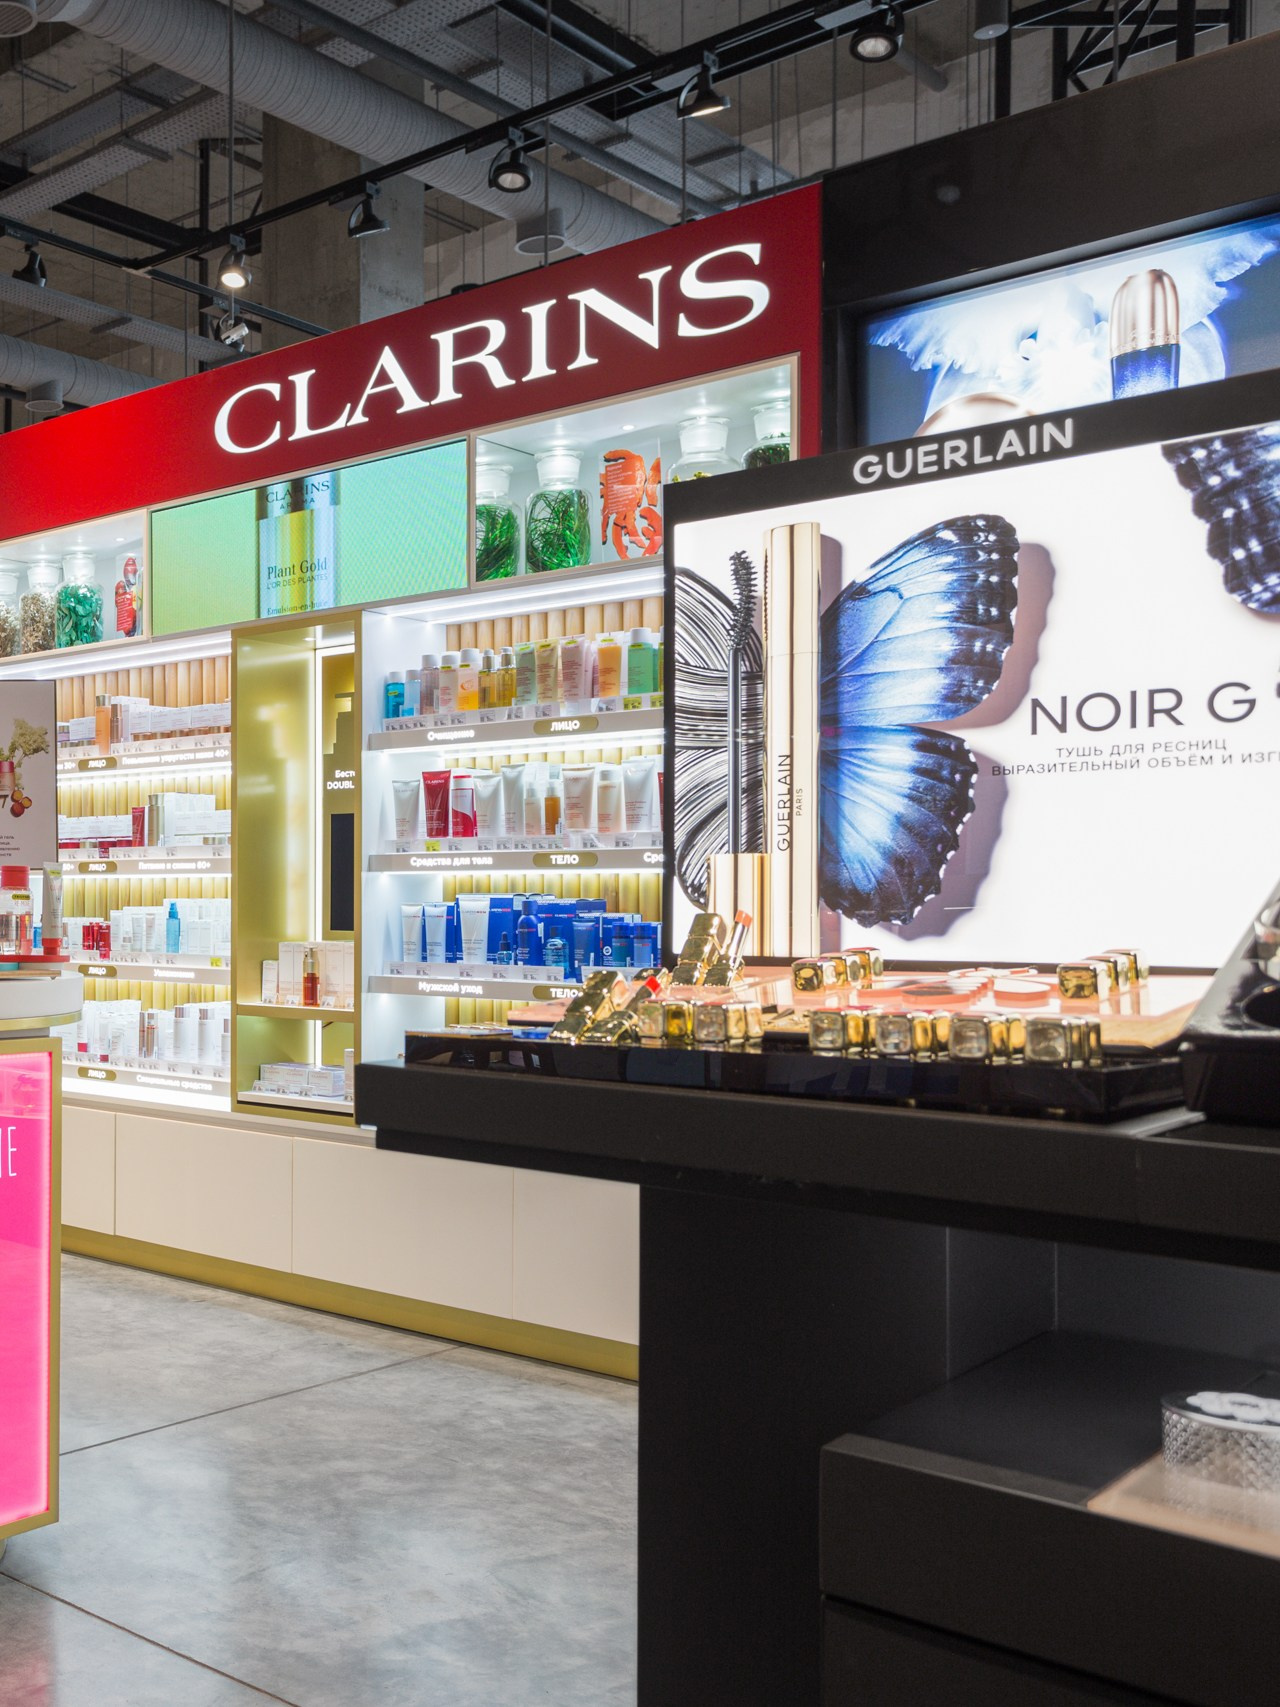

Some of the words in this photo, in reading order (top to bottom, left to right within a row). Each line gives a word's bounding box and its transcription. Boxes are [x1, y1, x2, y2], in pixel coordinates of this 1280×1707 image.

[213, 242, 772, 456] CLARINS
[852, 418, 1074, 486] GUERLAIN
[266, 480, 330, 503] CLAINS
[267, 563, 296, 580] Plant
[300, 557, 328, 574] Gold
[283, 578, 297, 587] DES
[1030, 687, 1184, 736] NOIR
[1207, 682, 1257, 724] G
[550, 719, 580, 732] ЛИЦО
[427, 729, 475, 742] Очищение
[215, 749, 229, 759] 40+
[1056, 746, 1103, 759] ТУШЬ
[1109, 743, 1145, 757] ДЛЯ
[1152, 738, 1228, 753] РЕСНИЦ
[88, 758, 107, 769] ЛИЦО
[991, 757, 1141, 777] ВЫРАЗИТЕЛЬНЫЙ
[1148, 752, 1214, 769] ОБЪЁМ
[1222, 753, 1234, 765] И
[1241, 750, 1280, 764] ИЗГ
[327, 781, 355, 790] DOUBL
[776, 753, 792, 852] GUERLAIN
[794, 787, 804, 816] PARIS
[410, 856, 452, 868] Средства
[452, 857, 468, 867] для
[470, 856, 493, 865] тела
[550, 854, 580, 865] ТЕЛО
[88, 862, 107, 873] ЛИЦО
[88, 966, 107, 976] ЛИЦО
[418, 981, 459, 994] Мужской
[460, 984, 483, 995] уход
[550, 988, 578, 999] ТЕЛО
[87, 1069, 107, 1079] ЛИЦО
